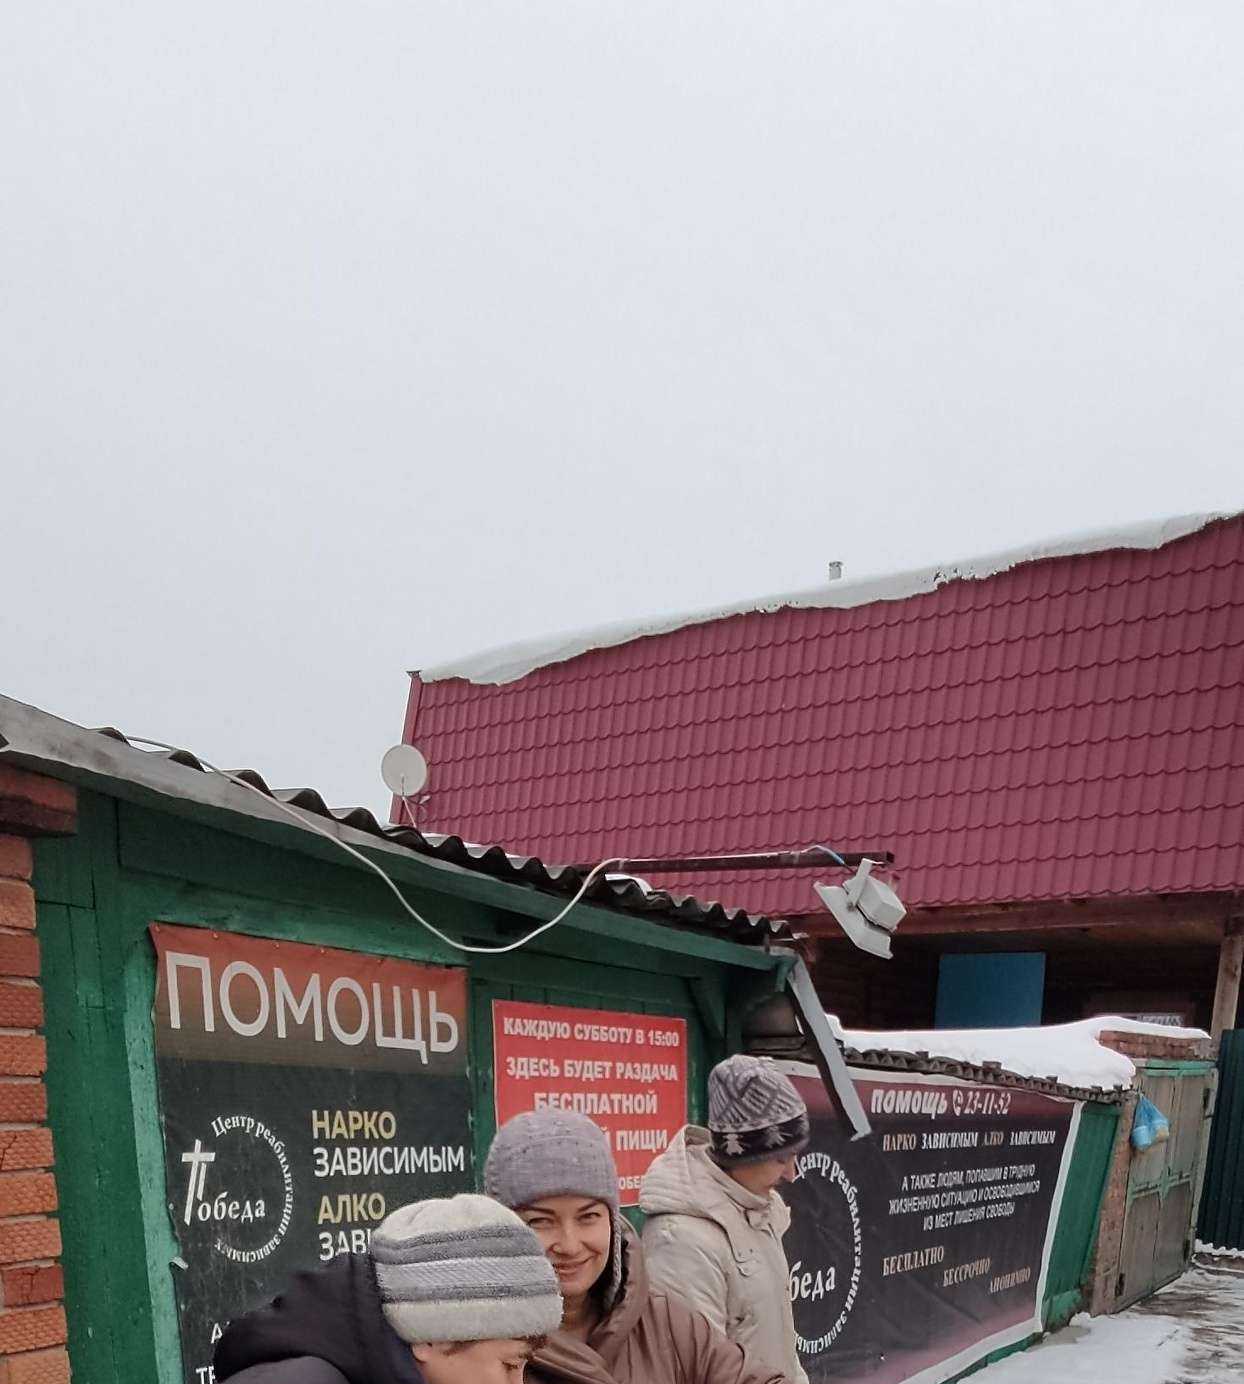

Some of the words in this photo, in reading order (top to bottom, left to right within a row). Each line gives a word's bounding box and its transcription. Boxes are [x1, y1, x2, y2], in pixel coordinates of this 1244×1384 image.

[166, 951, 459, 1064] ПОМОЩЬ
[503, 1017, 570, 1040] КАЖДУЮ
[574, 1023, 632, 1043] СУББОТУ
[636, 1030, 645, 1044] В
[648, 1030, 680, 1047] 15:00
[506, 1056, 559, 1079] ЗДЕСЬ
[563, 1059, 612, 1082] БУДЕТ
[616, 1062, 678, 1083] РАЗДАЧА
[533, 1090, 658, 1115] БЕСПЛАТНОЙ
[964, 1090, 1012, 1115] 23-11-52
[312, 1110, 396, 1139] НАРКО
[616, 1129, 667, 1153] ПИЩИ
[883, 1133, 917, 1151] НАРКО
[921, 1131, 979, 1150] ЗАВИСИМЫМ
[982, 1130, 1005, 1146] АЛКО
[1009, 1130, 1056, 1146] ЗАВИСИМЫМ
[211, 1116, 255, 1138] Центр
[256, 1122, 294, 1236] реабилитации
[313, 1146, 465, 1177] ЗАВИСИМЫМ
[901, 1176, 909, 1192] А
[910, 1172, 937, 1190] ТАКЖЕ
[318, 1193, 386, 1225] АЛКО
[889, 1194, 941, 1215] ЖИЗНЕННУЮ
[940, 1188, 977, 1207] СИТУАЦИЮ
[923, 1214, 934, 1231] ИЗ
[934, 1211, 953, 1229] МЕСТ
[830, 1161, 862, 1312] реабилитации
[882, 1246, 944, 1277] БЕСПЛАТНО
[943, 1257, 991, 1287] БЕССРОЧНО
[789, 1262, 835, 1301] беда
[796, 1311, 847, 1354] зависимы
